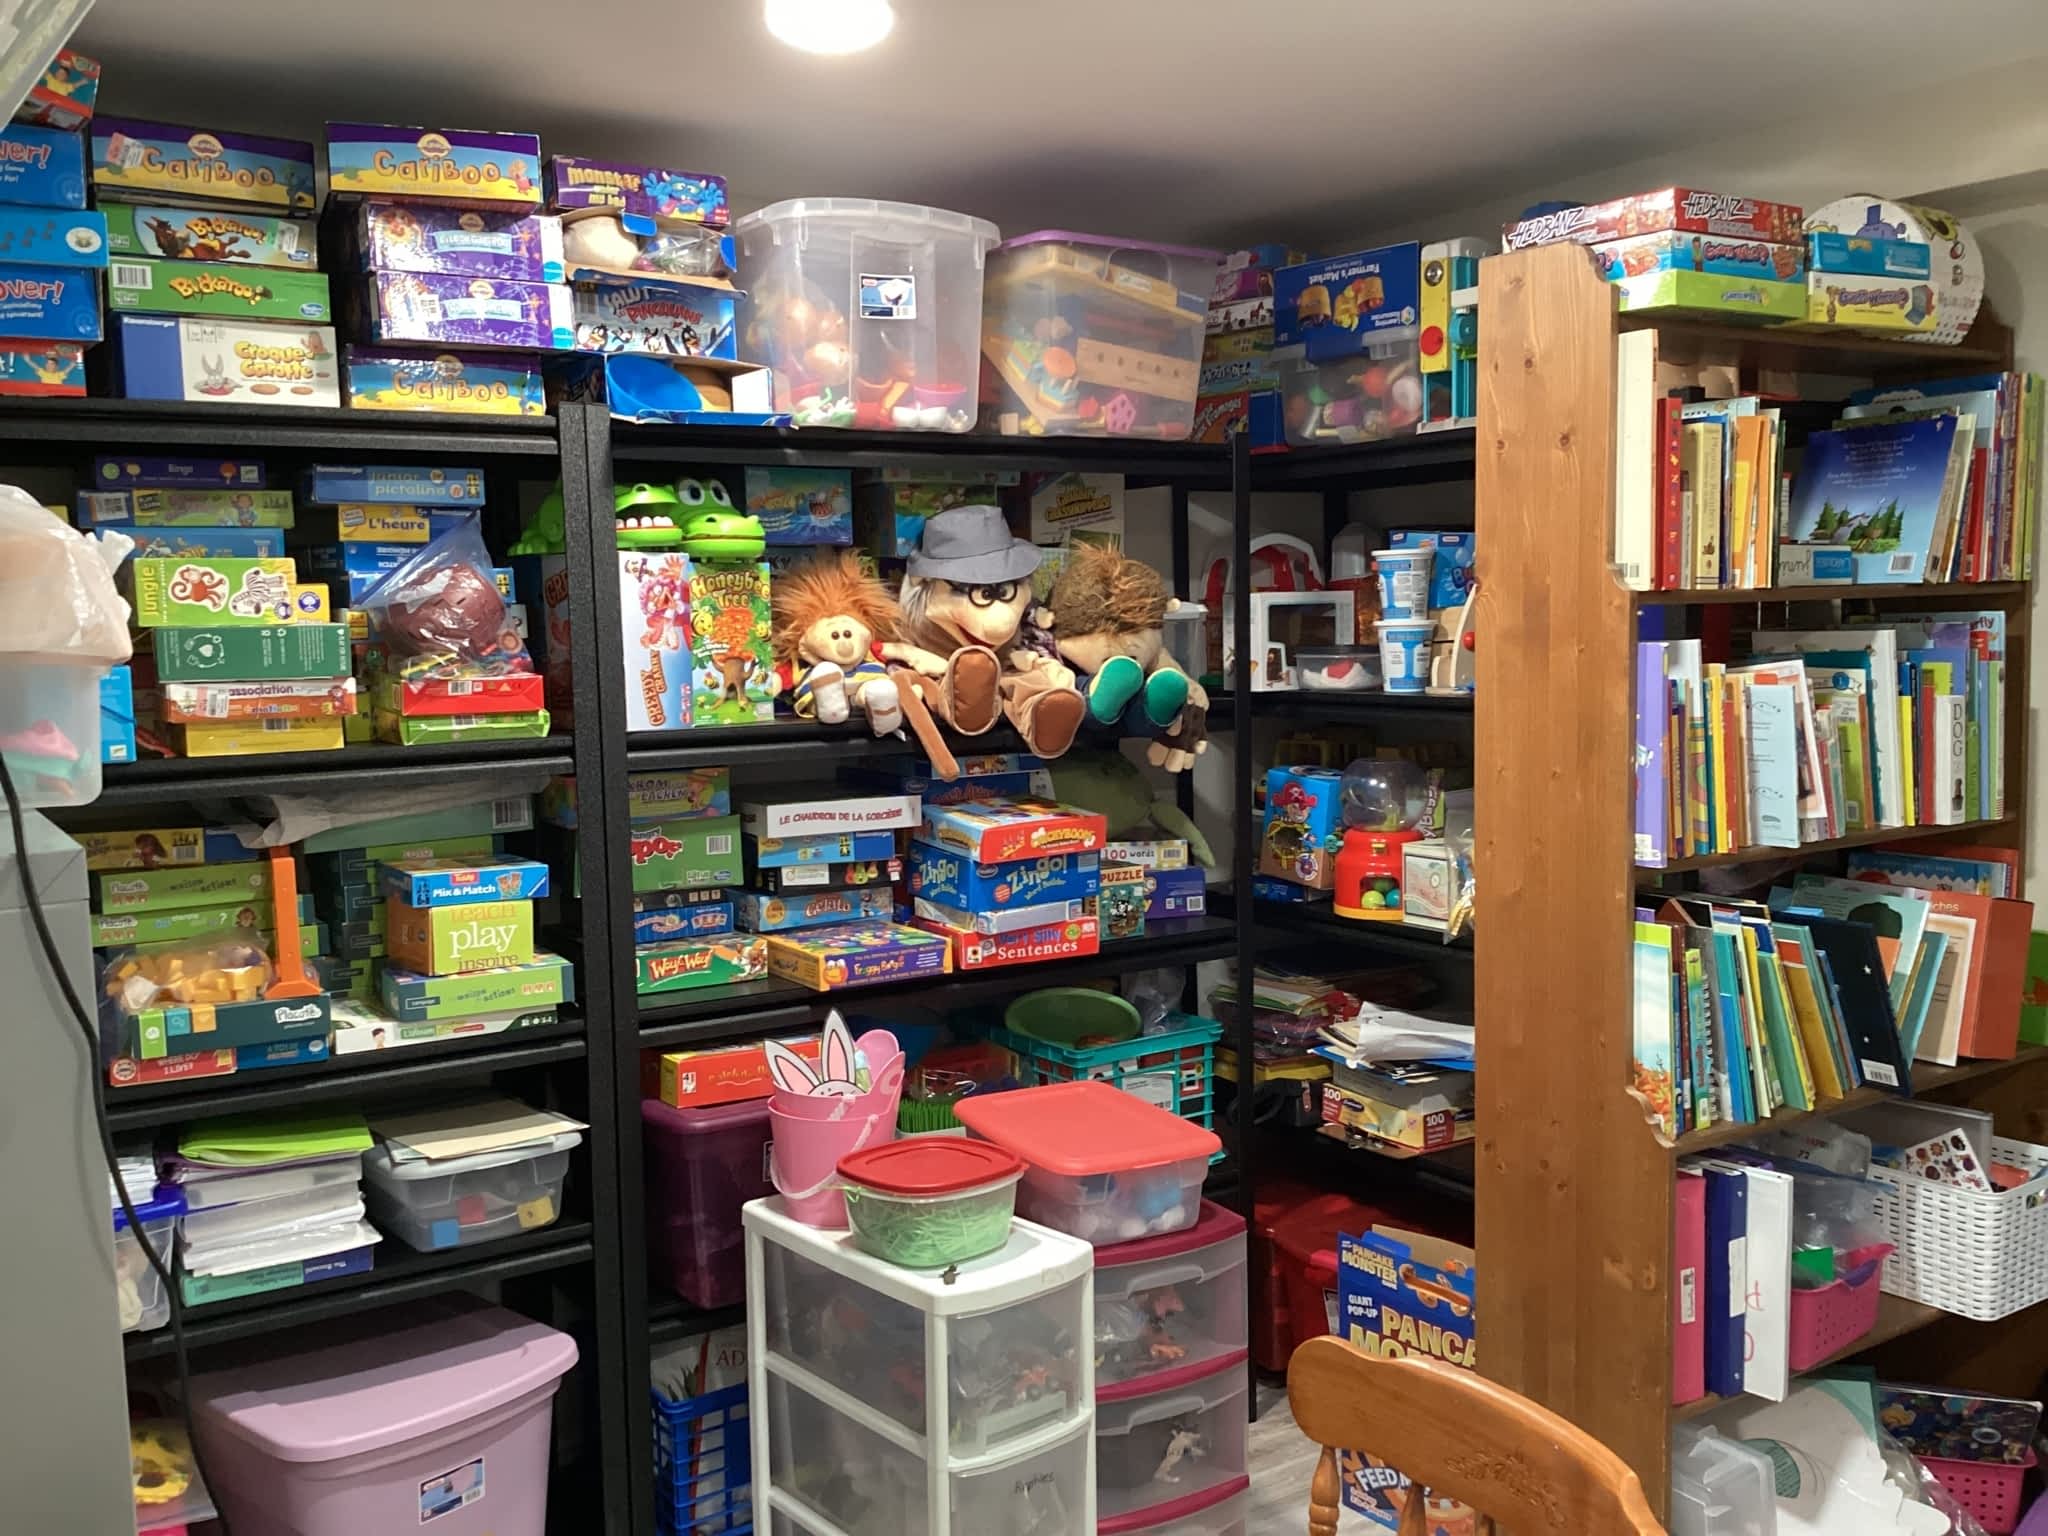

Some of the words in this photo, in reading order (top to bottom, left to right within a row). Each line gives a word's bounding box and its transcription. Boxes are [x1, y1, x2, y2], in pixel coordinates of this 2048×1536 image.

[368, 517, 426, 531] L'heure
[690, 571, 771, 599] Honeybee
[712, 589, 749, 608] Tree
[228, 684, 294, 697] association
[1953, 703, 1963, 757] DOG
[1100, 868, 1143, 883] PUZZLE
[463, 884, 496, 895] Match
[449, 921, 518, 959] play
[998, 941, 1078, 961] Sentences
[458, 953, 520, 971] inspire
[1323, 1087, 1341, 1101] 100
[1426, 1113, 1445, 1127] 100
[1352, 1244, 1395, 1269] PANCAKE
[1342, 1250, 1398, 1286] MONSTER
[1347, 1305, 1379, 1319] POP-UP
[1355, 1467, 1399, 1492] FEED
